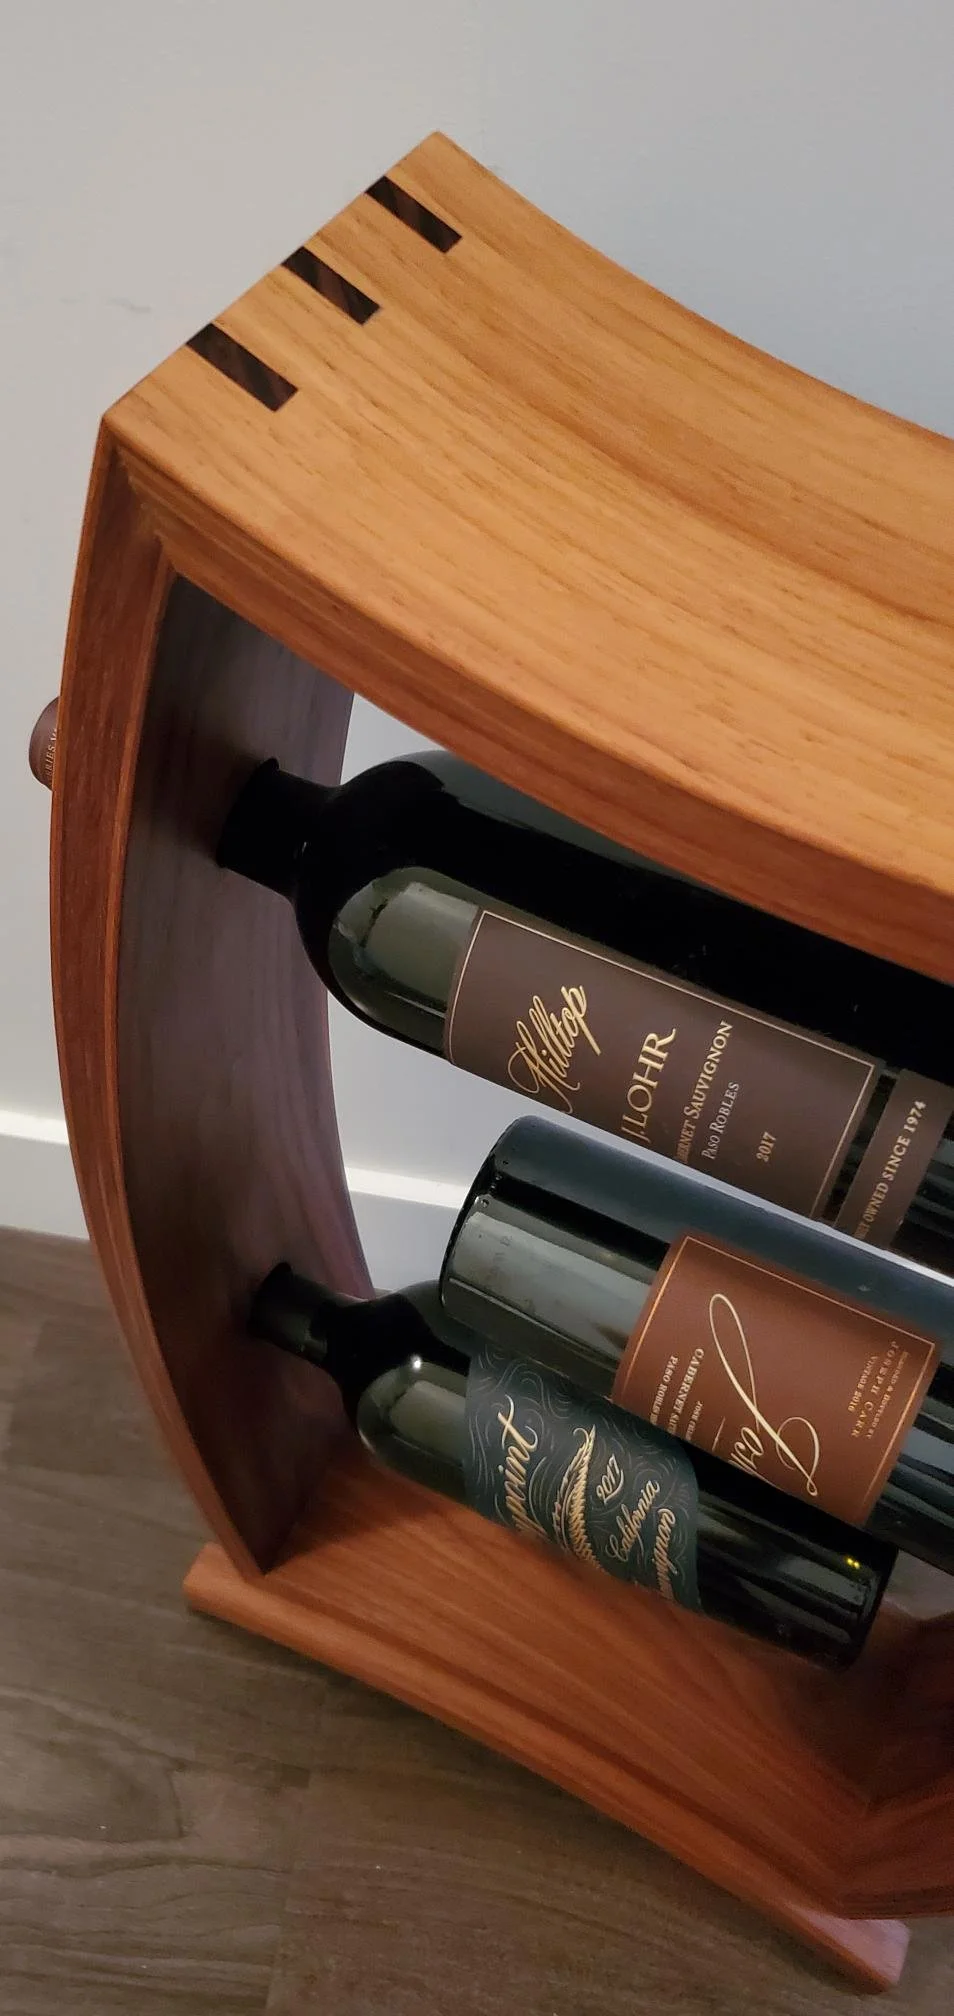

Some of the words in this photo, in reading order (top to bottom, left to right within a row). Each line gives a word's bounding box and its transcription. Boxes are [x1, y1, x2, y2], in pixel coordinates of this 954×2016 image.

[508, 985, 601, 1114] Hilltop
[684, 1020, 733, 1118] SAUVIGNON
[709, 1081, 740, 1134] ROBLES
[702, 1134, 721, 1160] PASO
[756, 1131, 777, 1162] 2017
[862, 1182, 889, 1222] OWNED
[881, 1135, 911, 1181] SINCE
[903, 1101, 926, 1133] 1974
[663, 1355, 678, 1382] PASO
[673, 1348, 704, 1414] CABERNET
[596, 1453, 624, 1505] 2017
[605, 1480, 660, 1563] California
